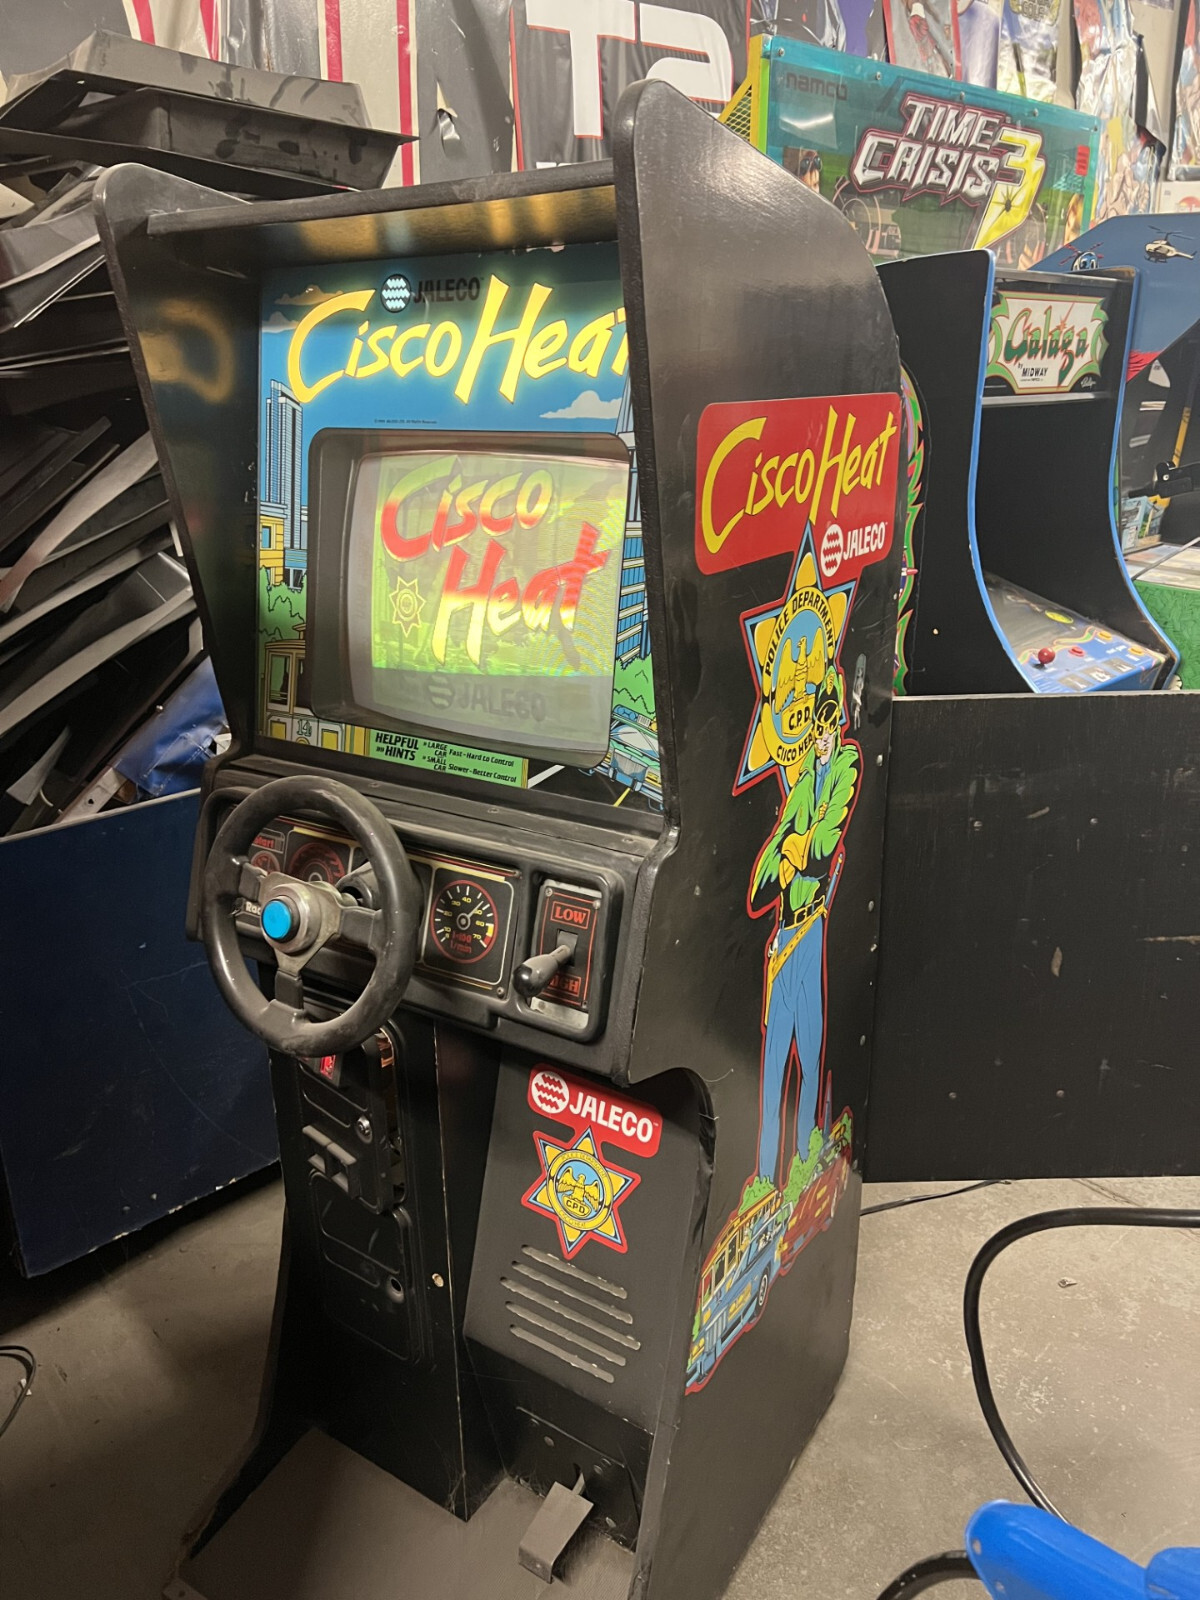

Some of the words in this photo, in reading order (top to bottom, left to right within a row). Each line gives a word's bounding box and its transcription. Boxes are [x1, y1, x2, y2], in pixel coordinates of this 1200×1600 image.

[786, 72, 848, 100] namco
[905, 100, 996, 147] TIME
[854, 134, 999, 198] CRISIS
[972, 129, 1046, 249] 3
[414, 276, 482, 303] JALECO
[288, 289, 463, 404] Cisco
[1004, 305, 1089, 387] Galaga
[1022, 368, 1048, 377] MIDWAY
[702, 416, 815, 555] Cisco
[809, 404, 898, 526] Heat
[381, 455, 555, 561] Cisco
[843, 523, 886, 561] JALECO
[430, 522, 610, 667] Heat
[765, 612, 790, 676] POLICE
[792, 591, 835, 648] DEPARTMENT
[375, 732, 419, 750] HELPFUL
[385, 745, 416, 761] HINTS
[427, 741, 448, 751] LARGE
[797, 731, 815, 757] HEA
[426, 755, 447, 765] SMALL
[491, 757, 515, 767] Control
[493, 772, 517, 783] Control
[462, 896, 472, 904] 40
[555, 906, 586, 924] LOW
[569, 1091, 654, 1144] JALECO
